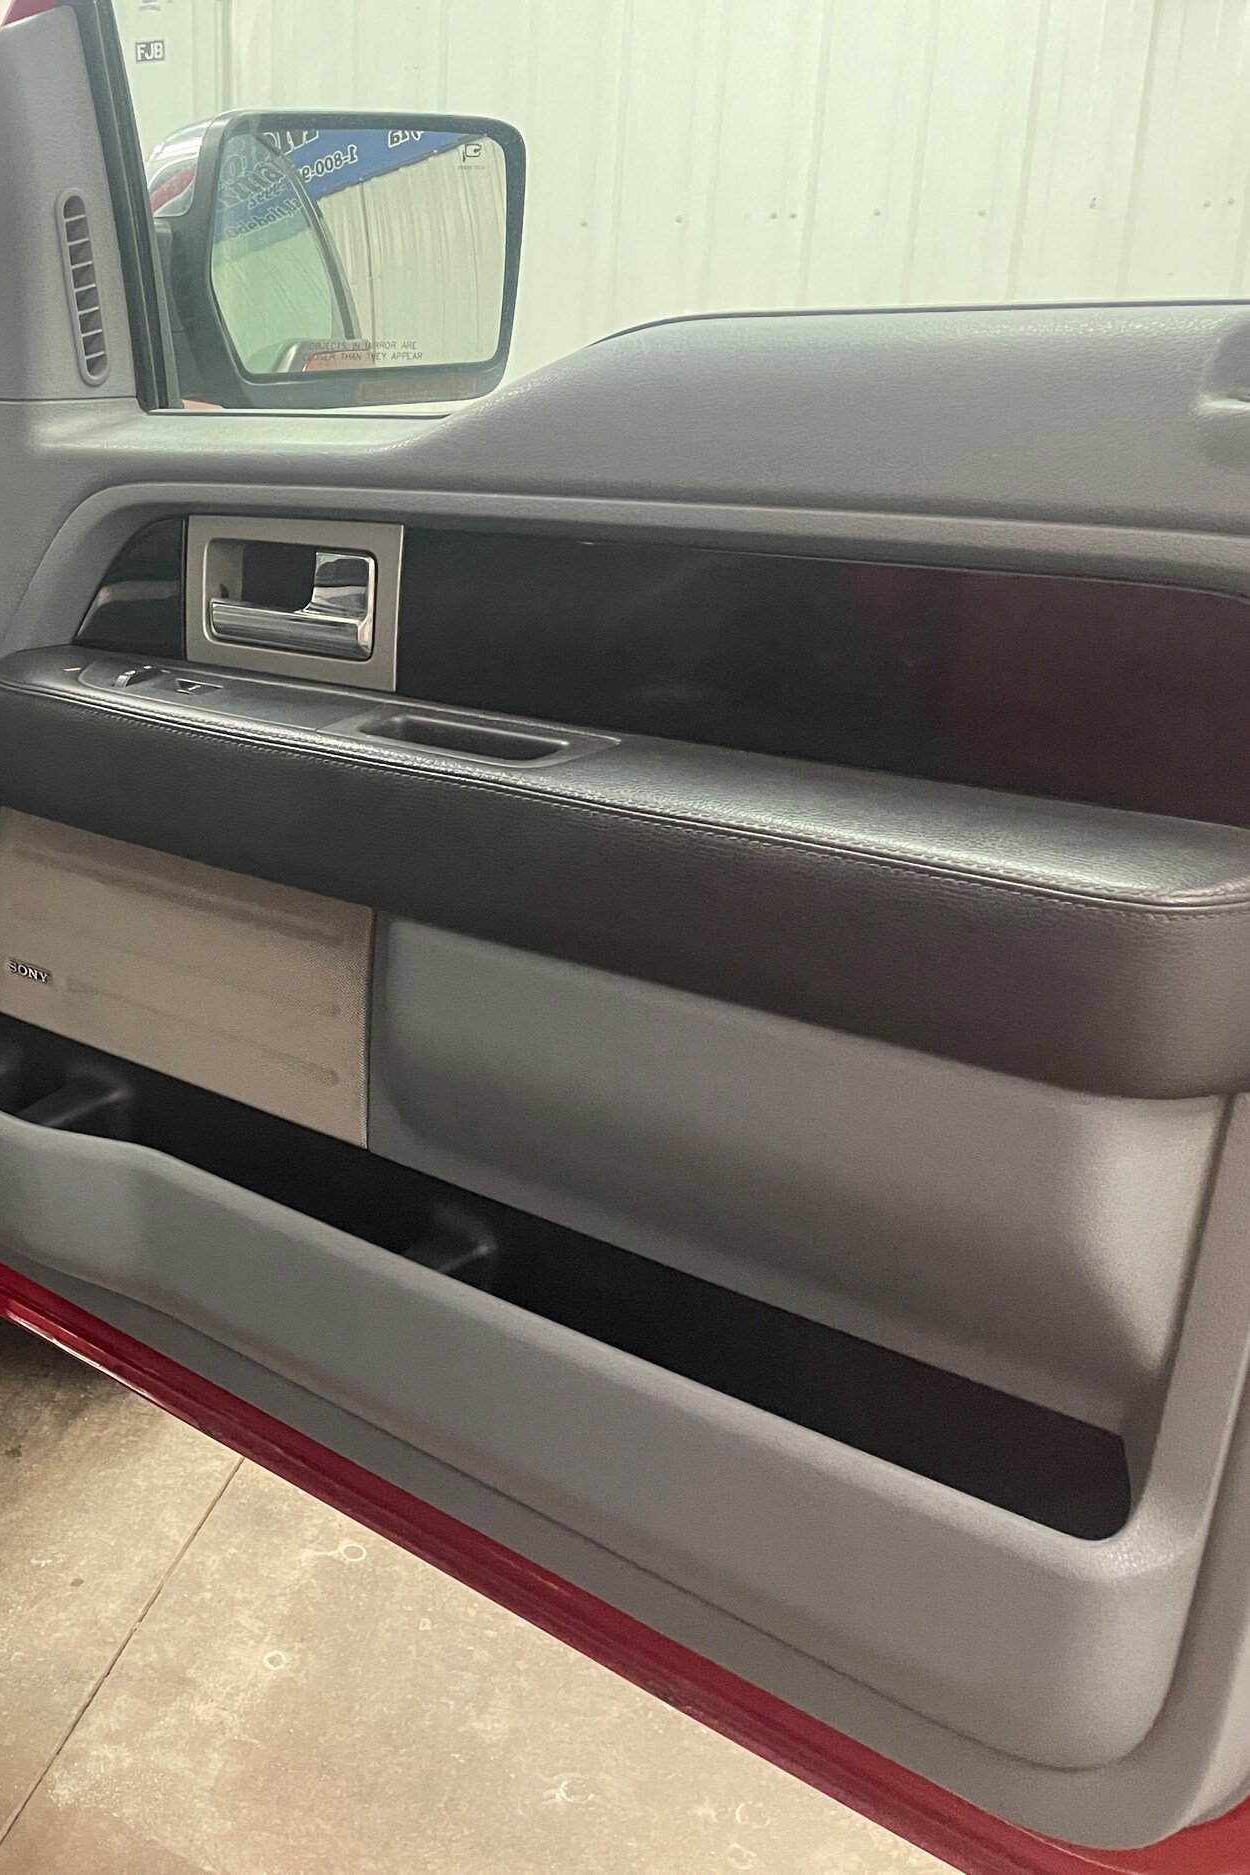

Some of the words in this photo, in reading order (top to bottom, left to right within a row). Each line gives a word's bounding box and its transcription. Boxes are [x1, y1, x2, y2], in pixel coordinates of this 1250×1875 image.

[137, 42, 163, 61] FJB
[310, 341, 347, 351] OBJECTS
[352, 341, 361, 350] IN
[365, 341, 398, 350] MIRROR
[401, 341, 418, 350] ARE
[341, 352, 362, 360] THAN
[366, 352, 388, 361] THEY
[391, 351, 423, 360] APPEAR
[8, 961, 49, 983] SONY
